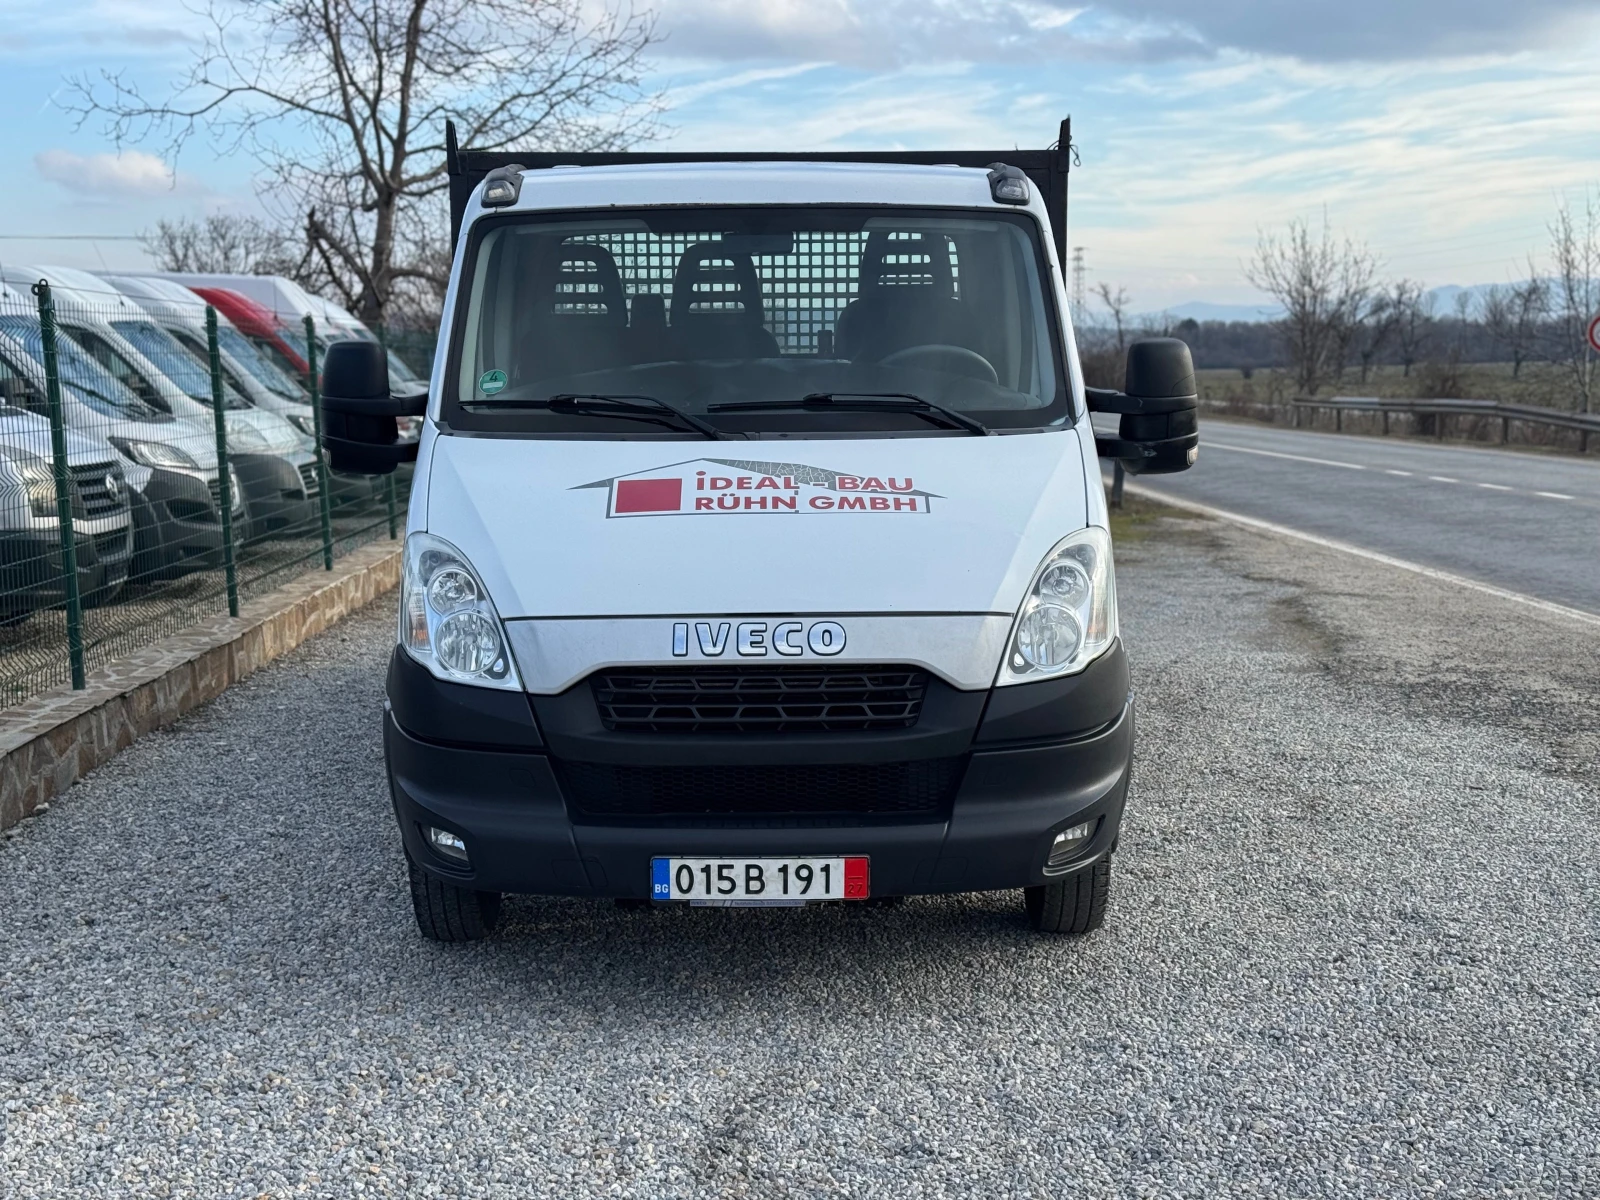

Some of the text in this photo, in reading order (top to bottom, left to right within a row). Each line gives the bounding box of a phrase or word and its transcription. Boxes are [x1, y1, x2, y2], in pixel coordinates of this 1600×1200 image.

[489, 371, 498, 382] 4
[838, 477, 914, 491] BAU
[695, 493, 918, 511] RÜHN GMBH
[671, 621, 847, 657] IVECO
[654, 884, 669, 893] BG
